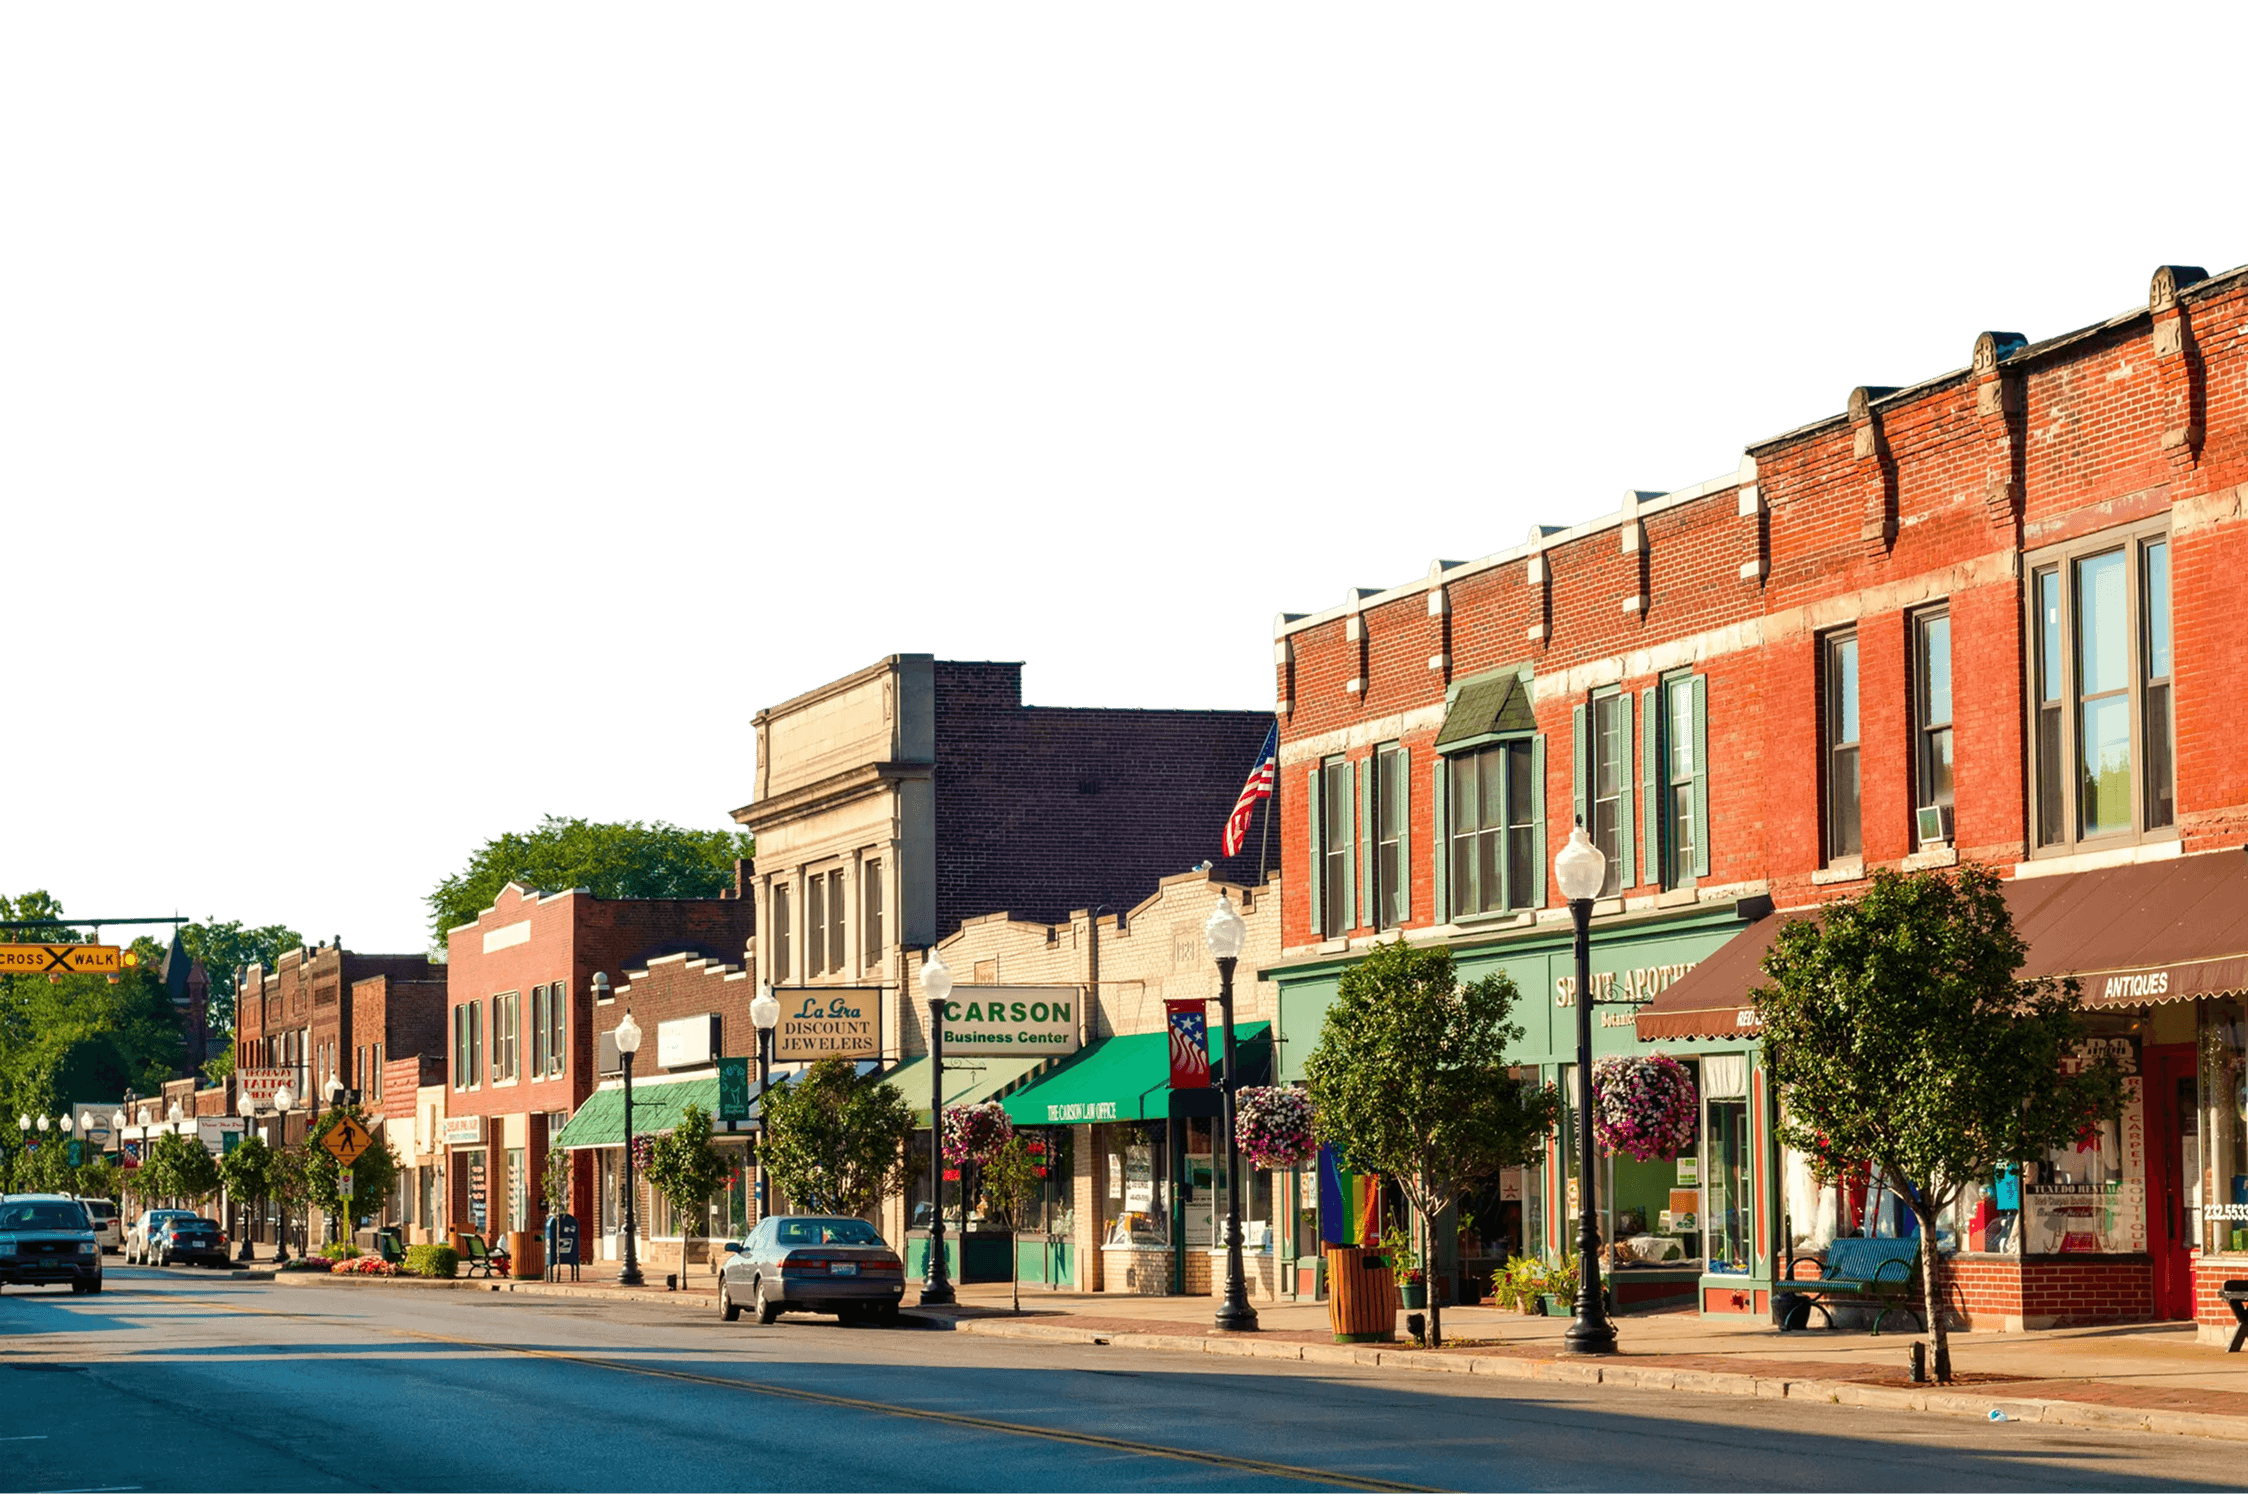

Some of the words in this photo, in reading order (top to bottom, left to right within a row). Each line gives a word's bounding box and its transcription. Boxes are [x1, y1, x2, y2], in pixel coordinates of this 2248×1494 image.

[0, 953, 44, 965] CROSS
[75, 953, 114, 966] WALK
[1556, 972, 1616, 1008] SPRIT
[1623, 962, 1699, 1002] APOTH
[2104, 972, 2168, 998] ANTIQUES
[793, 998, 824, 1019] La
[827, 998, 861, 1019] Gra
[943, 1001, 1071, 1022] CARSON
[1601, 1010, 1636, 1028] Botanic
[1736, 1010, 1755, 1027] RED
[784, 1021, 870, 1035] DISCOUNT
[944, 1030, 1013, 1043] Business
[1017, 1031, 1069, 1043] Center
[782, 1037, 873, 1051] JEWELERS
[241, 1079, 296, 1089] TATTOO
[2128, 1079, 2141, 1103] RD
[1047, 1104, 1058, 1121] THE
[1059, 1103, 1082, 1121] CARSON
[1083, 1103, 1095, 1120] LAW
[1096, 1102, 1116, 1120] OFFICE
[2128, 1114, 2142, 1167] CARPET
[2034, 1184, 2076, 1194] TUXEDO
[2078, 1184, 2123, 1194] RENTALS
